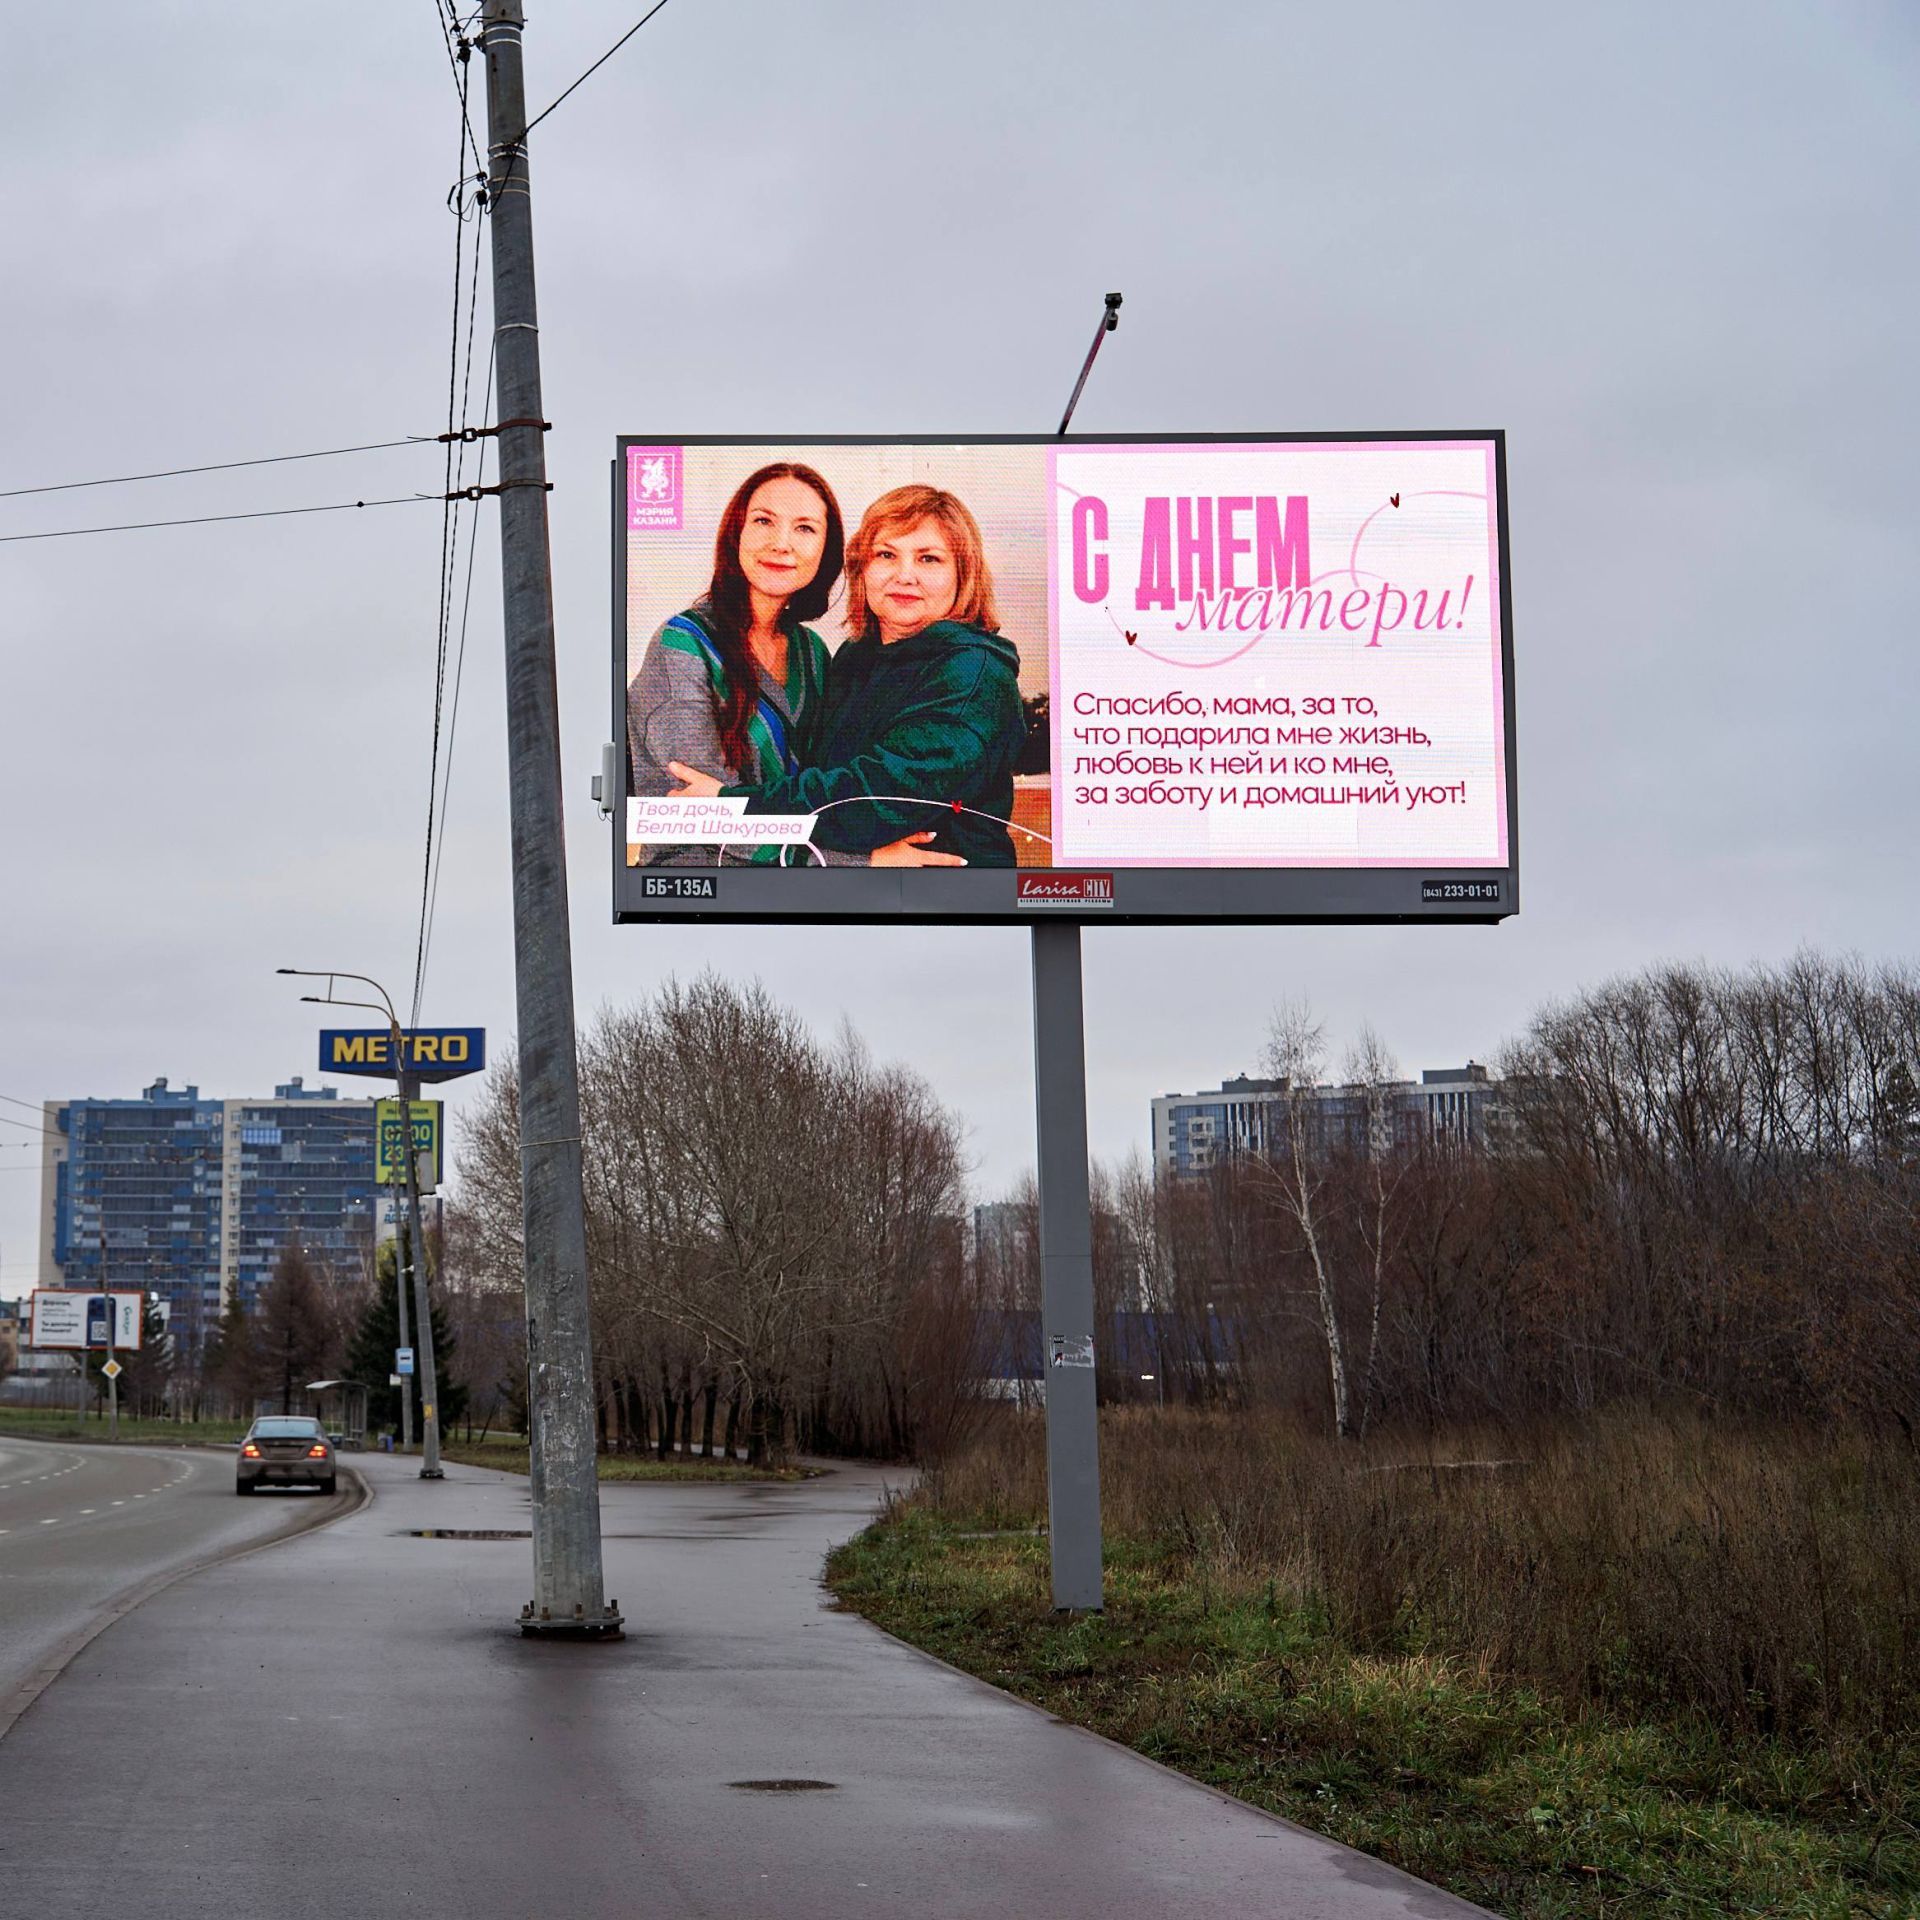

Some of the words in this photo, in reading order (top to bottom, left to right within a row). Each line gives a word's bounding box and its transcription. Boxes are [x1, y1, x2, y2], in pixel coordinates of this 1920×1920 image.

[633, 516, 677, 525] КАЗАНИ
[636, 507, 674, 516] МЭРИЯ
[1072, 496, 1109, 604] С
[1135, 495, 1312, 611] ДНЕМ
[1174, 575, 1473, 648] матери!
[1073, 691, 1207, 718] Спасибо,
[1213, 697, 1296, 718] мама,
[1302, 697, 1335, 715] за
[1341, 697, 1378, 718] то,
[1074, 727, 1120, 745] что
[1127, 727, 1269, 751] подарила
[1277, 727, 1332, 744] мне
[1339, 727, 1432, 747] жизнь,
[1074, 750, 1183, 774] любовь
[1189, 757, 1204, 774] к
[1210, 750, 1262, 774] ней
[1270, 757, 1287, 774] и
[1294, 757, 1326, 774] ко
[1333, 757, 1393, 777] мне,
[1075, 786, 1108, 804] за
[1115, 779, 1213, 811] заботу
[1220, 786, 1237, 804] и
[1243, 779, 1399, 809] домашний
[1405, 780, 1466, 811] уют!
[637, 801, 680, 816] Твоя
[683, 803, 733, 818] дочь,
[636, 819, 696, 834] Белла
[701, 820, 802, 837] Шакурова
[645, 878, 713, 896] ББ-135А
[1022, 879, 1080, 896] Larisa
[1083, 879, 1110, 897] CITY
[1444, 885, 1498, 897] 233-01-01
